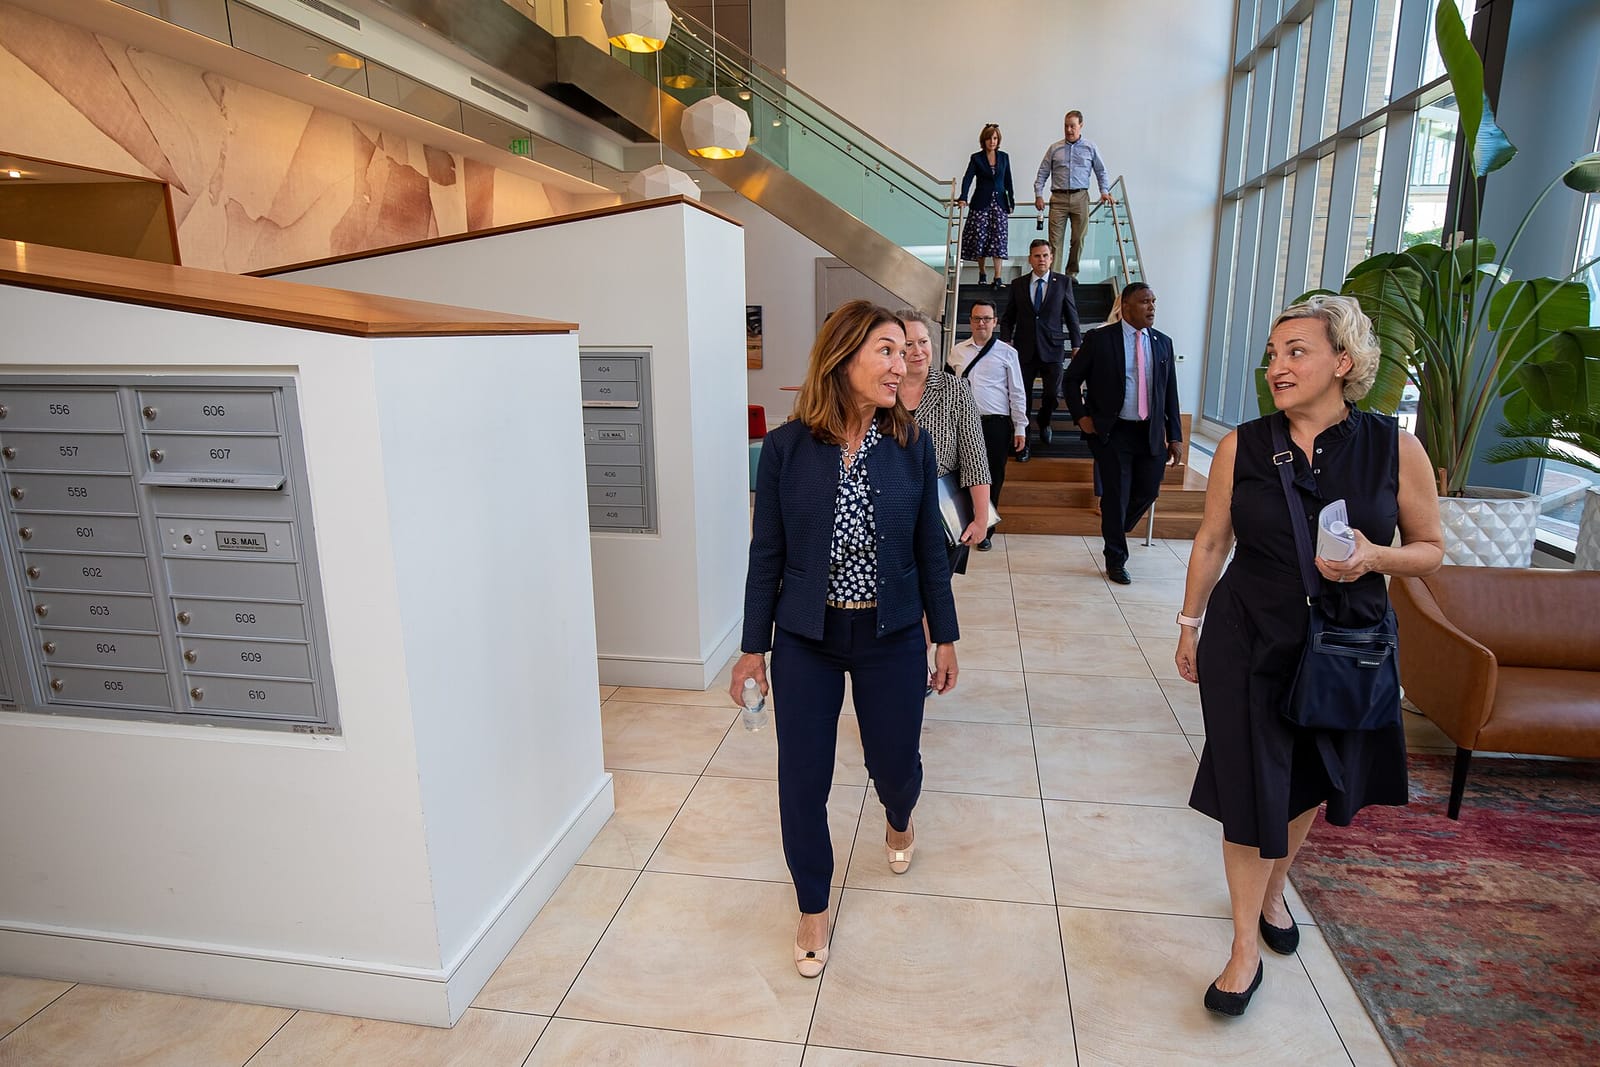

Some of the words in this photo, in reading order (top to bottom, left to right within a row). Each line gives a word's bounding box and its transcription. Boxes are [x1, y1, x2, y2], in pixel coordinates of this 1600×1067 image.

[49, 404, 70, 415] 556
[203, 405, 225, 417] 606
[59, 446, 79, 457] 557
[209, 448, 231, 460] 607
[67, 486, 87, 498] 558
[76, 527, 94, 538] 601
[223, 537, 239, 545] U.S.
[240, 538, 260, 546] MAIL
[82, 567, 102, 578] 602
[89, 605, 110, 616] 603
[235, 612, 256, 624] 608
[96, 643, 116, 654] 604
[240, 652, 262, 663] 609
[104, 680, 124, 691] 605
[248, 689, 266, 701] 610
